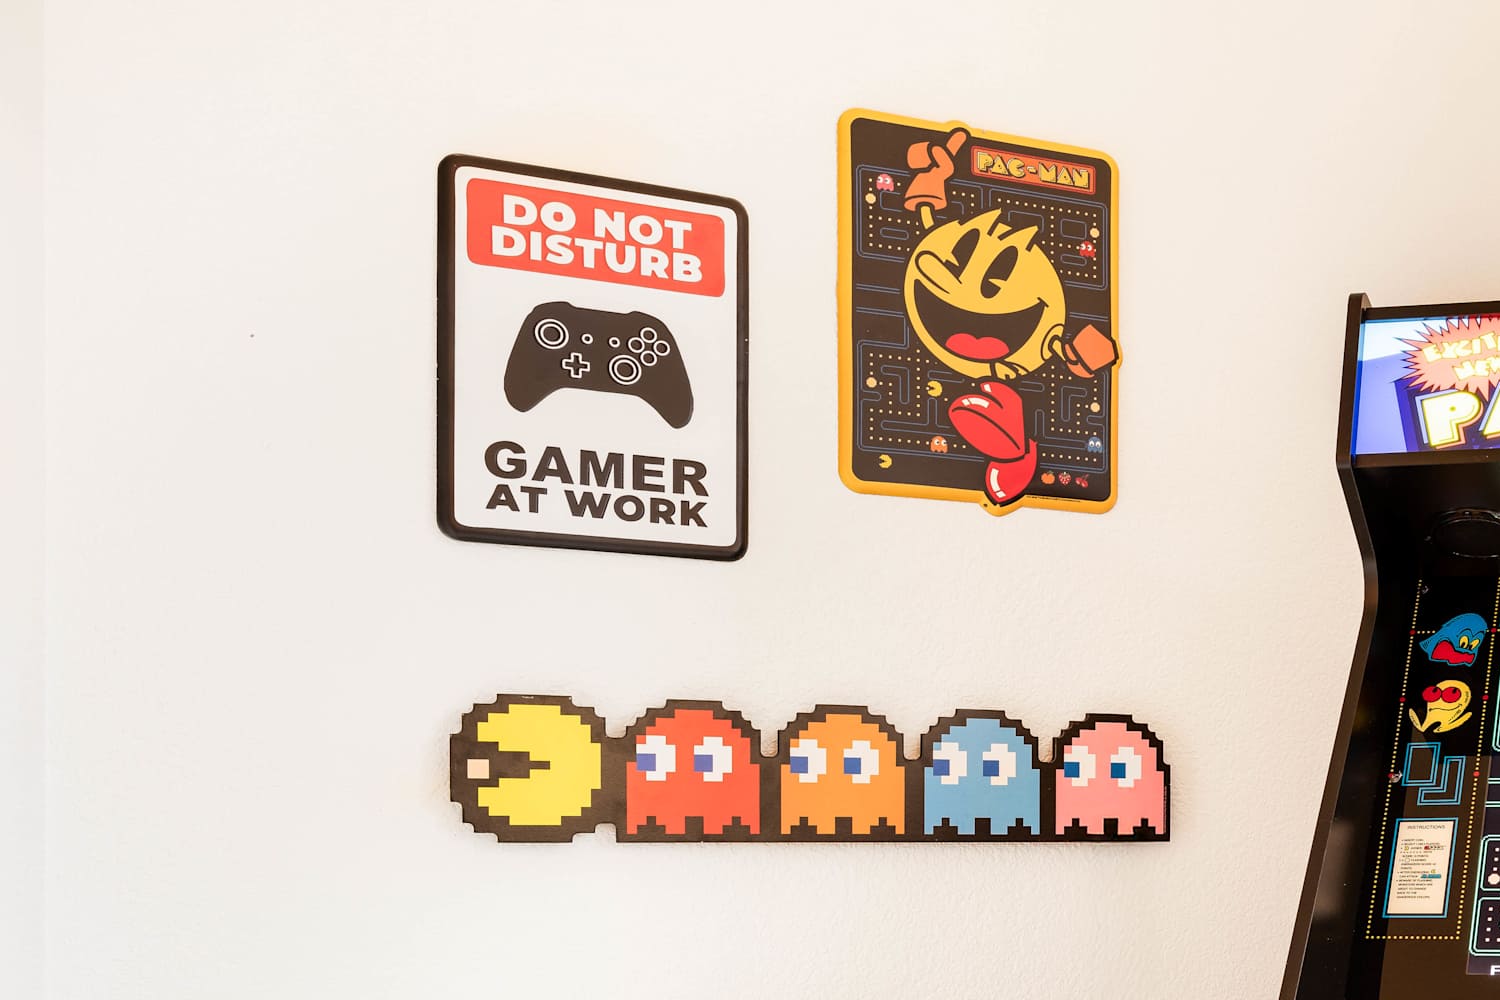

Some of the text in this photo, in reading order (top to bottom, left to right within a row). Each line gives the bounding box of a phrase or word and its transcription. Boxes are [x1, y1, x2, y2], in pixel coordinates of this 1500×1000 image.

[977, 151, 1090, 188] PAC-MAN
[502, 194, 692, 249] DO NOT
[491, 226, 703, 284] DISTURB
[484, 440, 709, 497] GAMER
[485, 485, 709, 528] AT WORK
